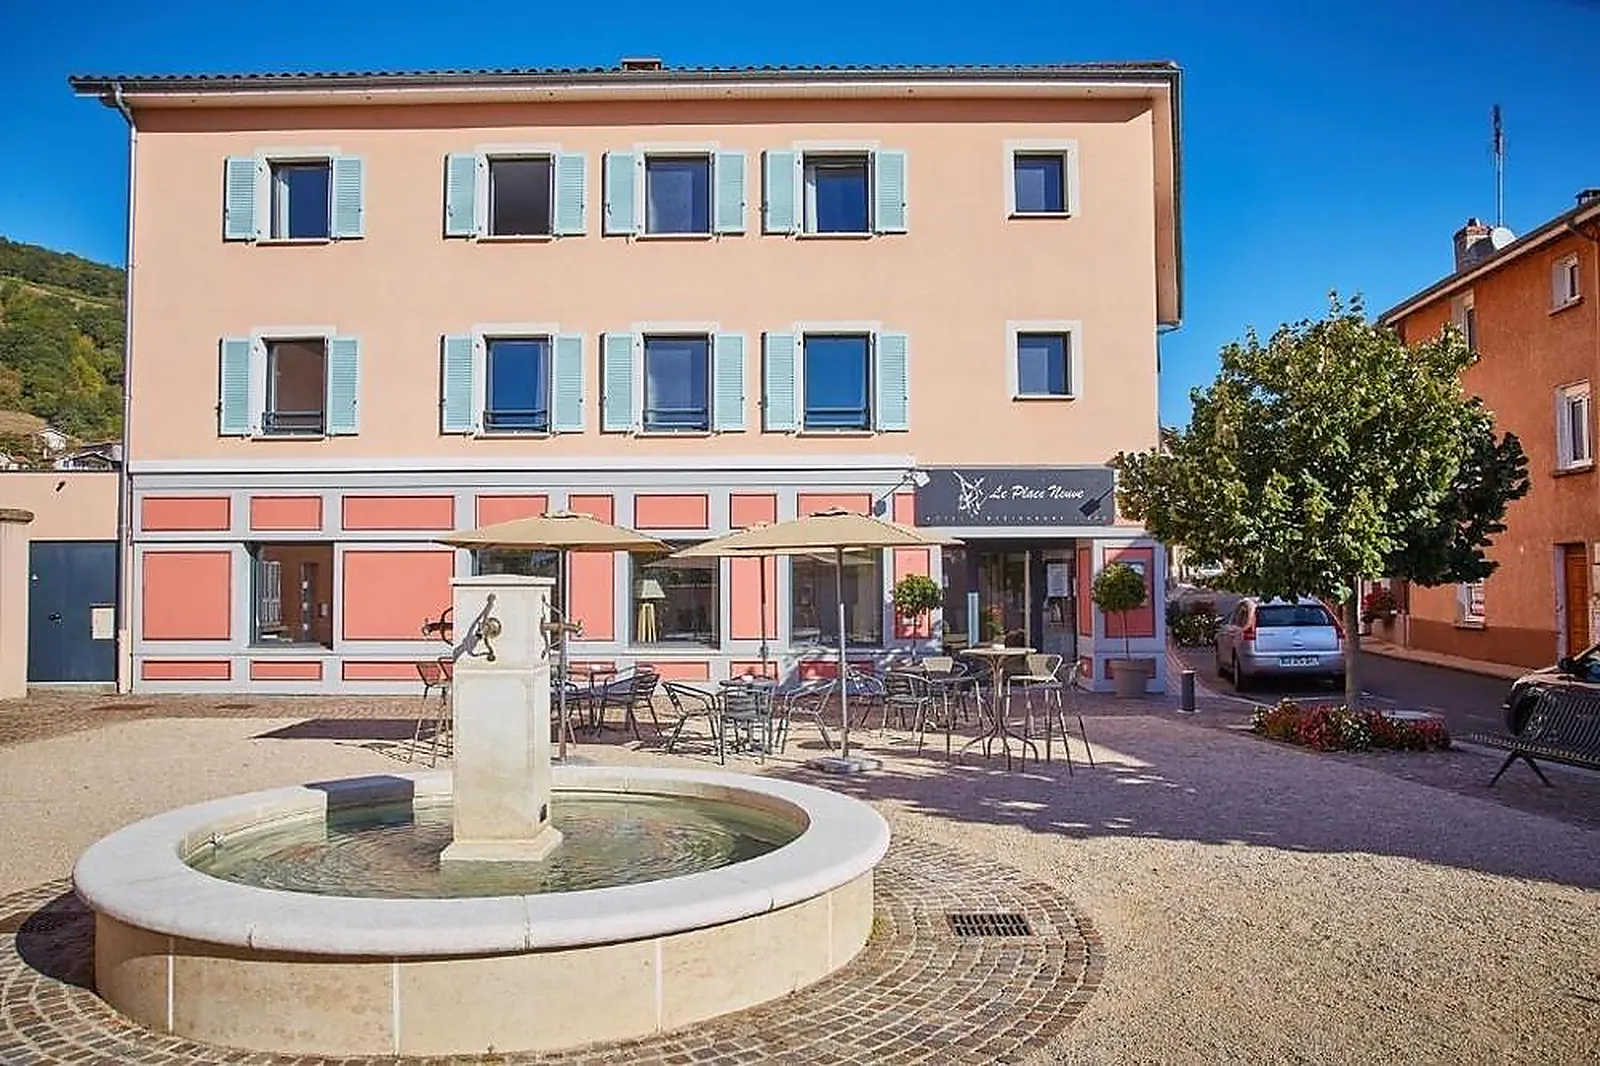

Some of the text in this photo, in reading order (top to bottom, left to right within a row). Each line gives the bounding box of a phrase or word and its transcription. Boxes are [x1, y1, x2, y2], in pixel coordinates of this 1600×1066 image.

[989, 485, 1084, 500] Le Place Neuve
